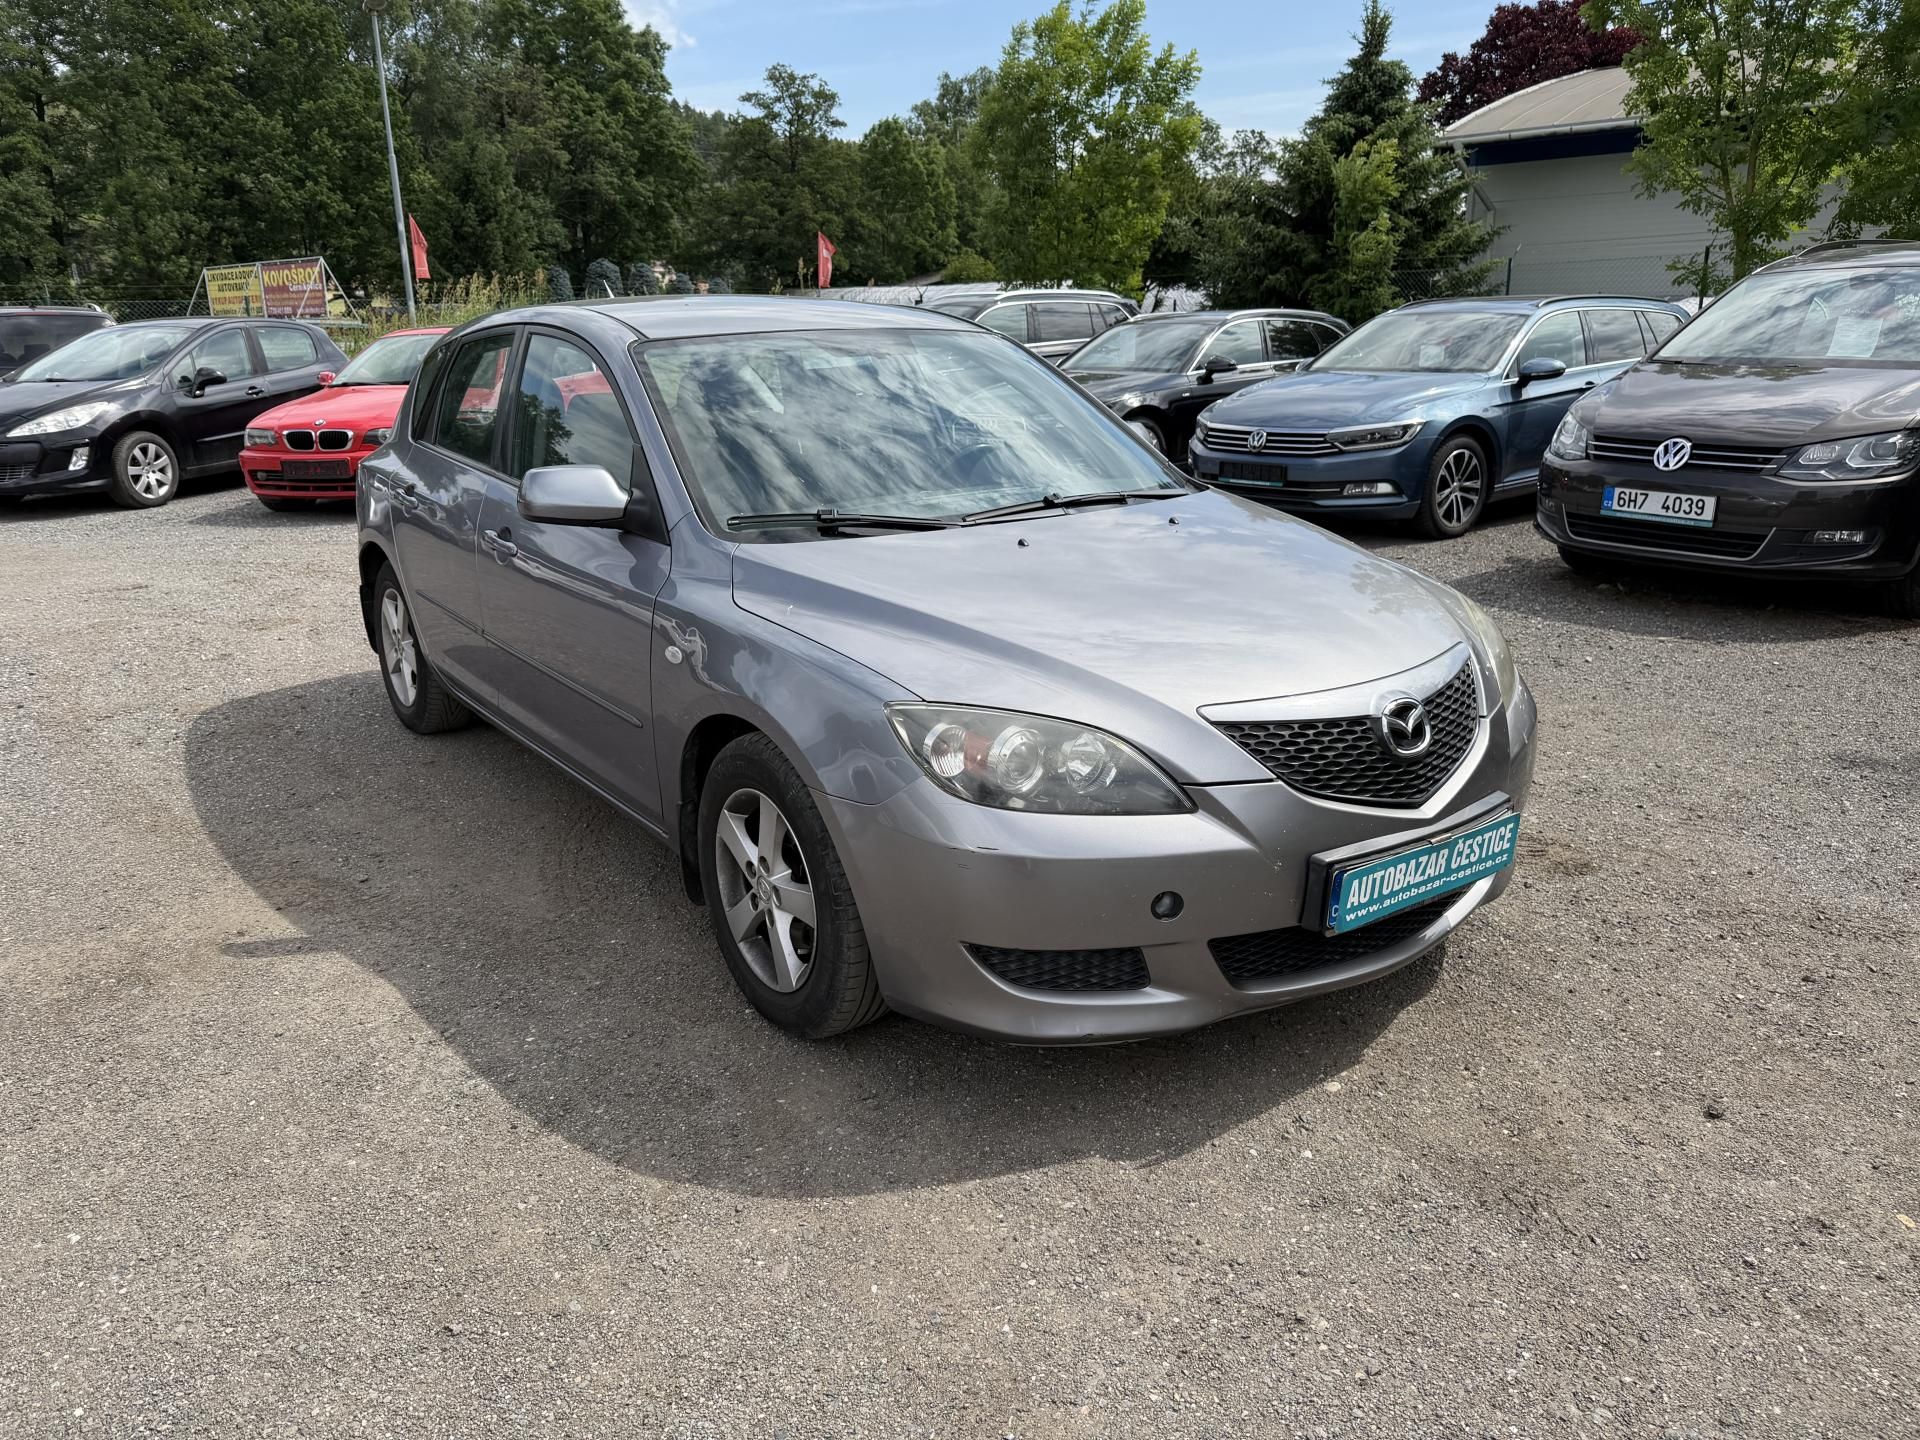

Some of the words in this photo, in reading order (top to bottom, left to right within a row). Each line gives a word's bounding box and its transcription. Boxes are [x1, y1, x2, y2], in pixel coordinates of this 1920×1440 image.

[1603, 500, 1612, 508] CZ
[1616, 490, 1649, 510] 6H7
[1661, 495, 1706, 516] 4039
[1345, 853, 1508, 922] www.autobazar-cestice.cz
[1346, 848, 1449, 909] AUTOBAZAR
[1451, 823, 1514, 869] ČESTICE
